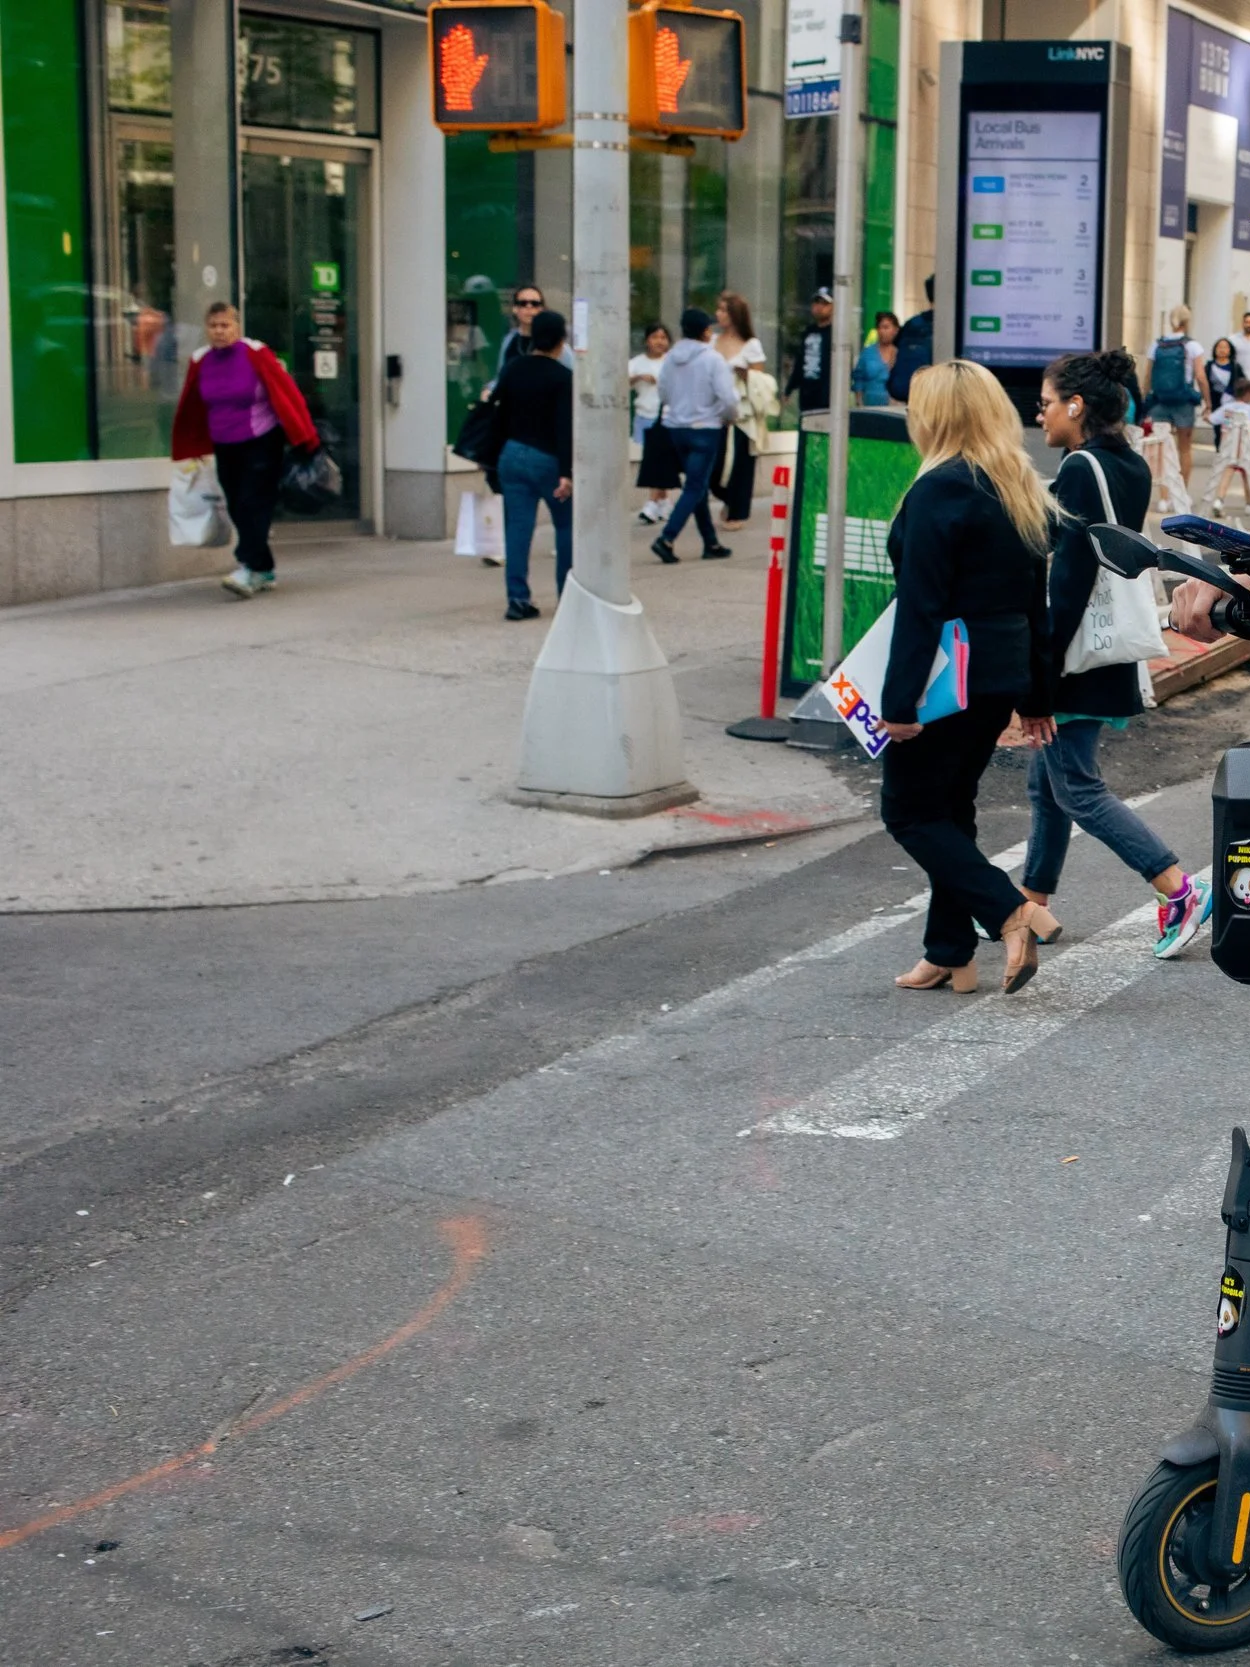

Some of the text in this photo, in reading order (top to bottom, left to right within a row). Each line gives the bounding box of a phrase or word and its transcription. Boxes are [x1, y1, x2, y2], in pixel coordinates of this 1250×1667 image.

[1047, 47, 1105, 60] LinkNYC
[974, 121, 1041, 134] Local Bus
[974, 137, 1026, 150] Arrivals
[313, 266, 338, 287] TD
[831, 671, 891, 756] FedEx
